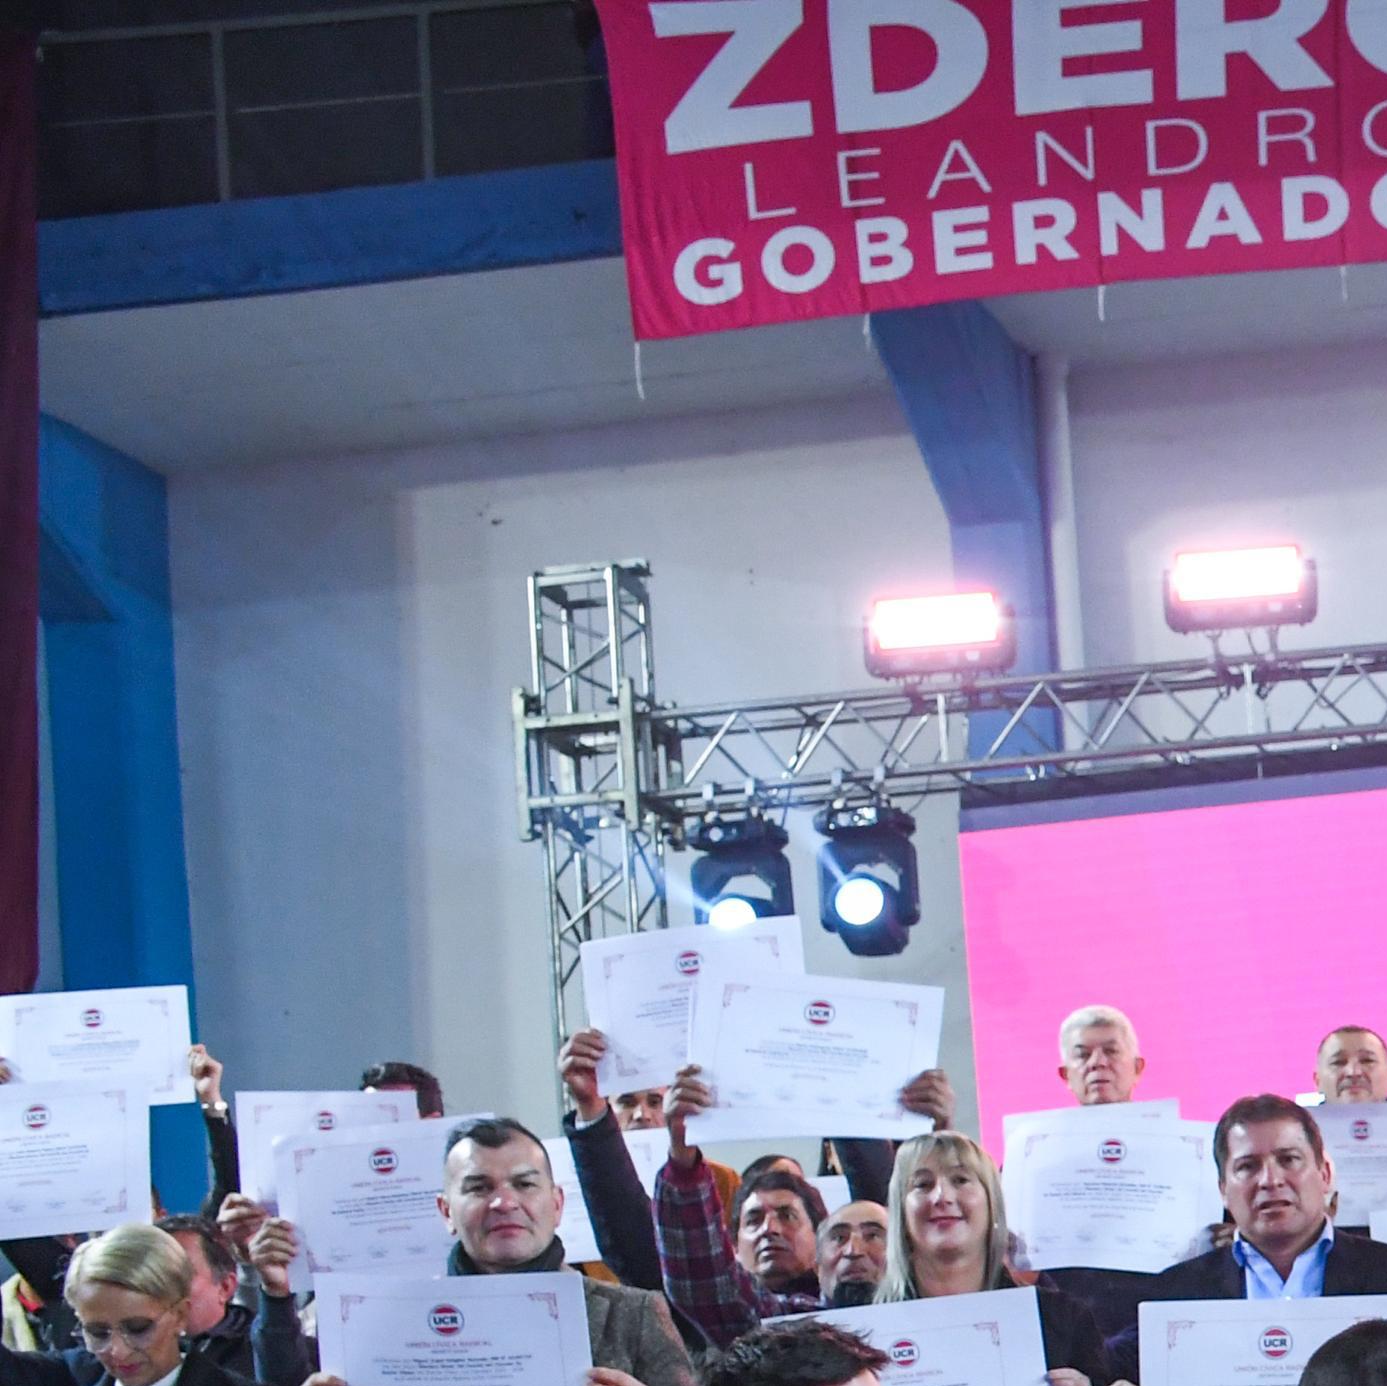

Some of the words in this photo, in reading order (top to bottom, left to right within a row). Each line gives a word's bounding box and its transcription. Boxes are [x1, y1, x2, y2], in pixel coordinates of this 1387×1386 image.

[809, 1009, 830, 1017] UCR
[1102, 1146, 1122, 1155] UCR
[373, 1157, 393, 1166] UCR
[433, 1316, 458, 1325] UCR
[1263, 1339, 1287, 1348] UCR
[893, 1349, 914, 1358] UCR
